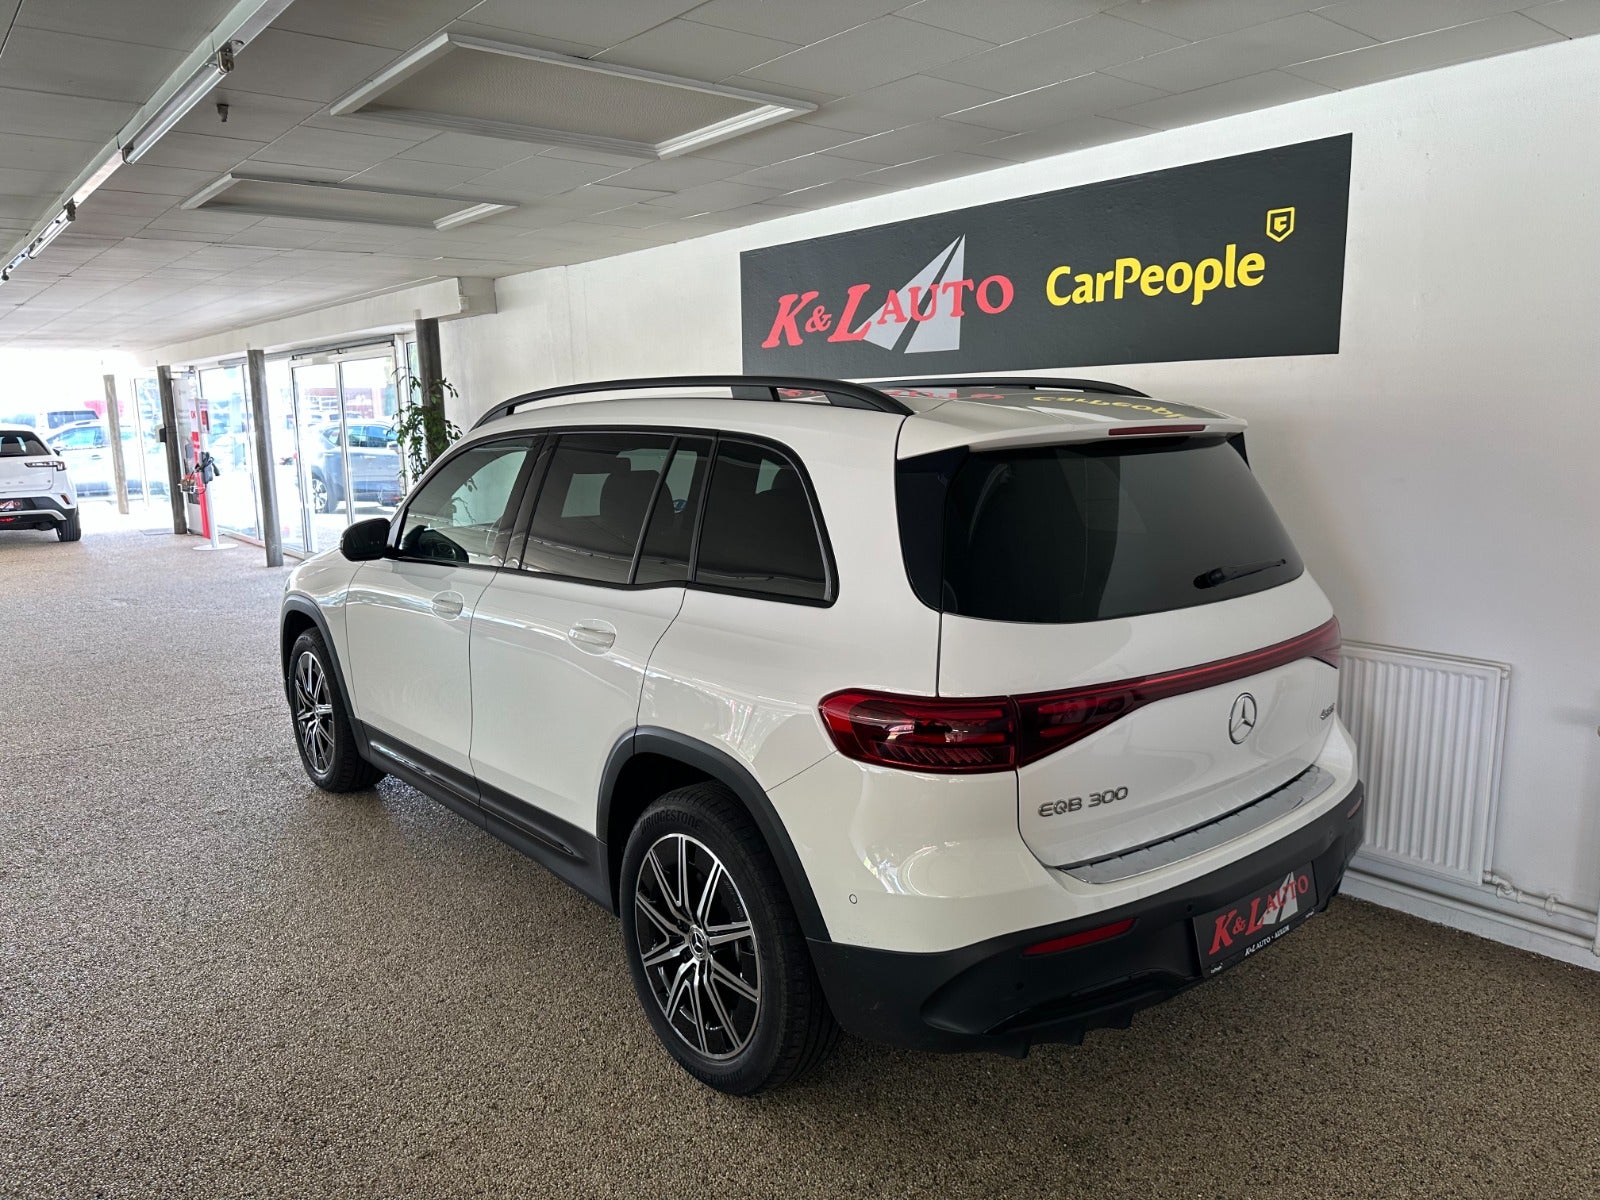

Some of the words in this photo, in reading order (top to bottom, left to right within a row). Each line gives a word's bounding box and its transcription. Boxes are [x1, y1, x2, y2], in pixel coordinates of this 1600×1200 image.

[1045, 243, 1266, 307] CarPeople
[876, 273, 1015, 326] AUTO
[1037, 796, 1083, 818] EQB
[1088, 785, 1129, 808] 300
[1266, 875, 1309, 913] AUTO
